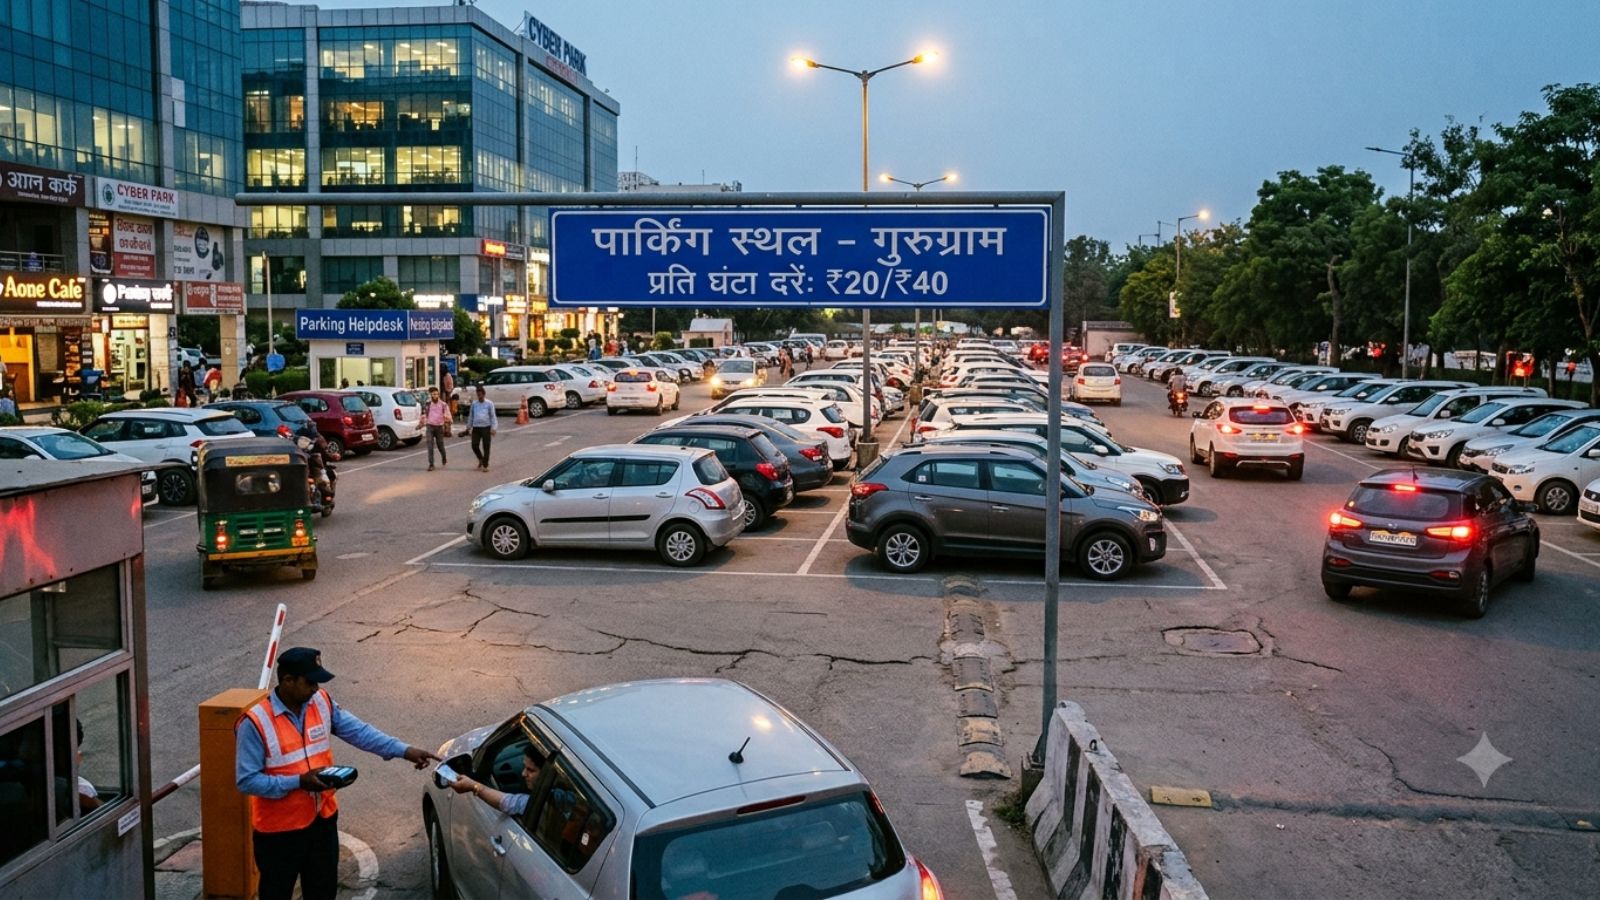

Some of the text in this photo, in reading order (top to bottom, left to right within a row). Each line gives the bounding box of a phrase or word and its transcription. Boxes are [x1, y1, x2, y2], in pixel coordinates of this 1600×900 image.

[528, 16, 562, 60] CYBER
[117, 183, 148, 200] CYBER
[151, 189, 175, 204] PARK
[591, 217, 713, 256] पार्किंग
[728, 227, 822, 256] स्थल
[870, 227, 1008, 267] गुरुग्राम
[4, 275, 46, 298] Aone
[647, 263, 949, 299] प्रति घंटा दरें: ₹20/₹40
[300, 316, 404, 335] Parking Helpdesk
